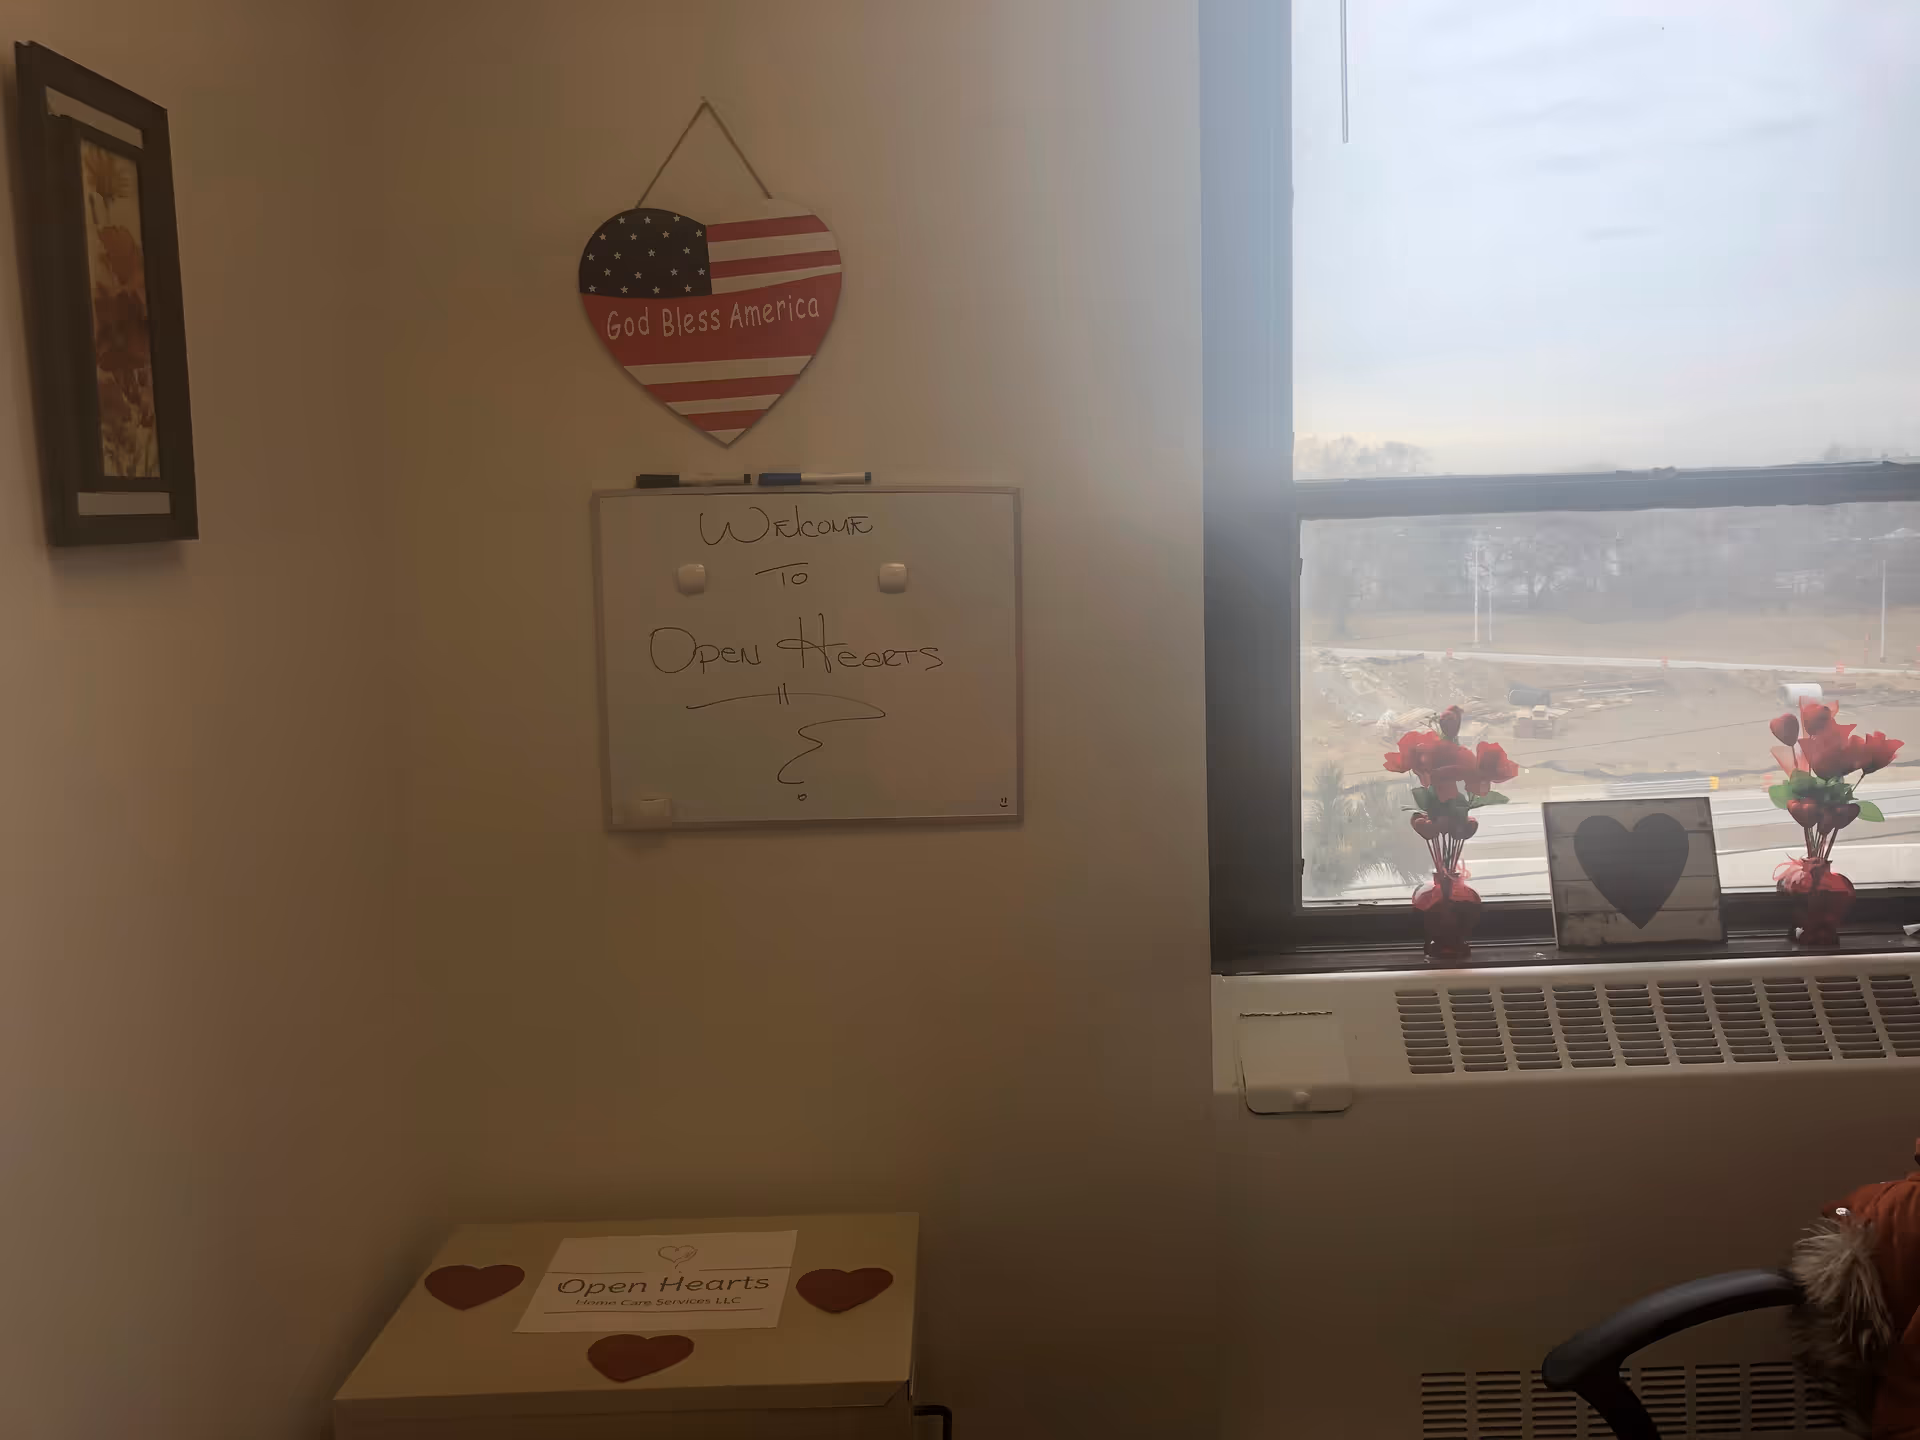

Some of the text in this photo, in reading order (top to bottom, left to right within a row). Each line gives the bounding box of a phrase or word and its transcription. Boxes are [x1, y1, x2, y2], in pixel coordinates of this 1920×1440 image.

[606, 295, 820, 340] God Bless America
[557, 1275, 770, 1298] Open Hearts
[575, 1296, 742, 1307] Home Care Services LLC
